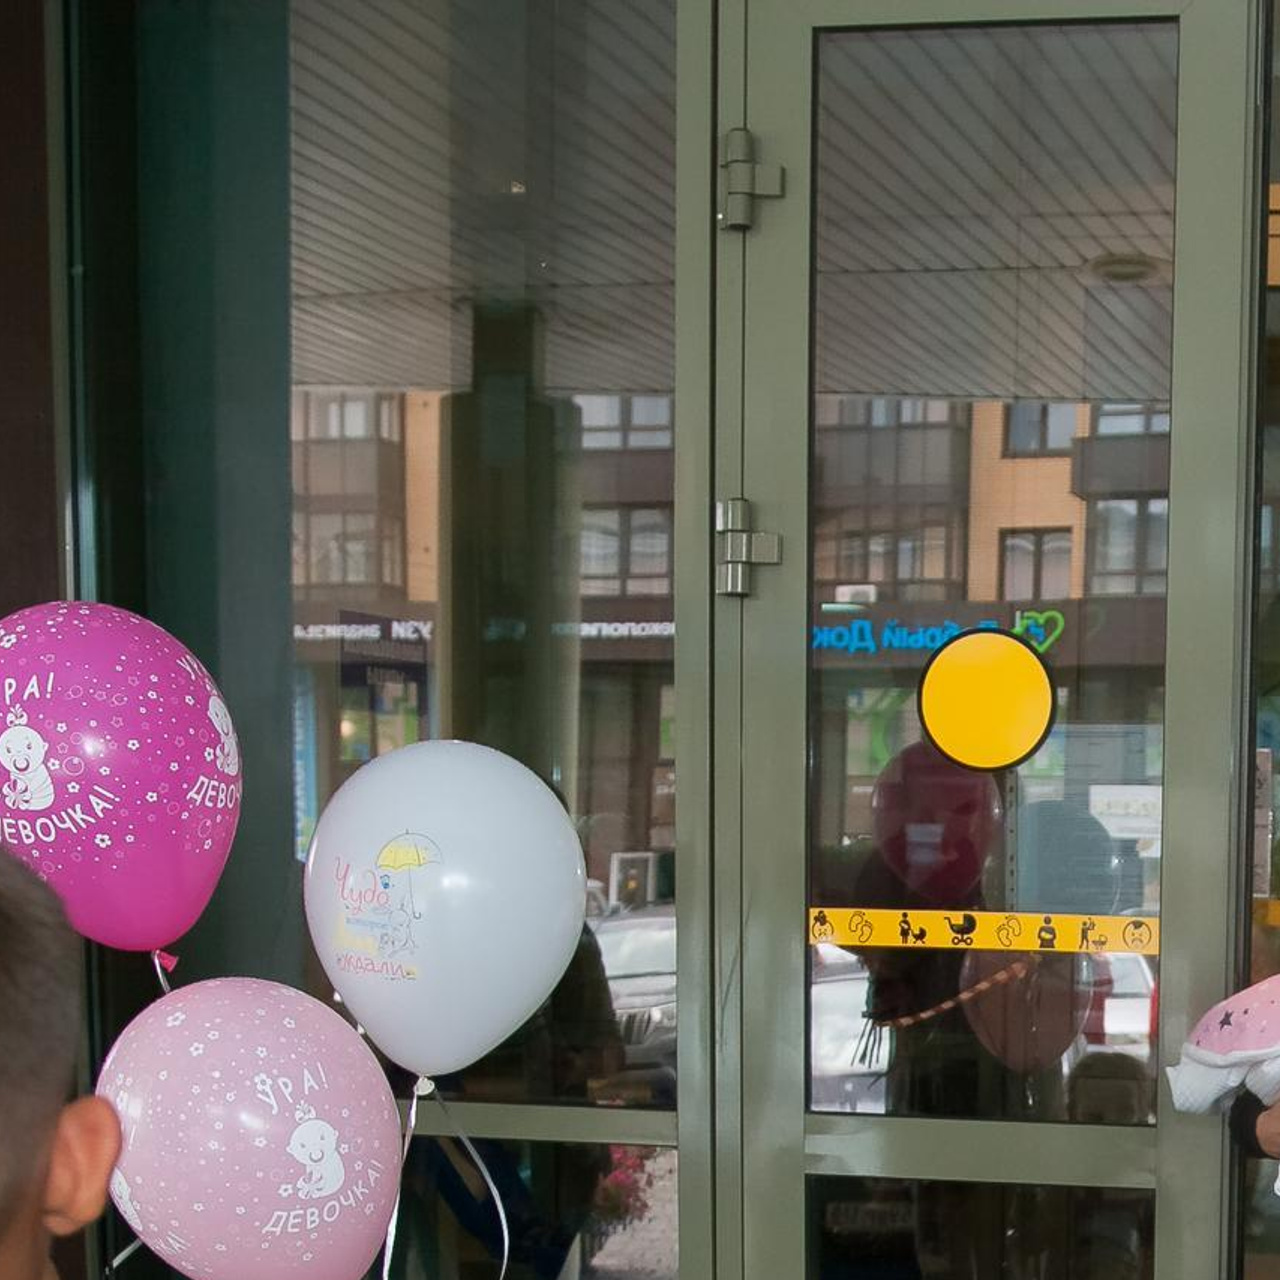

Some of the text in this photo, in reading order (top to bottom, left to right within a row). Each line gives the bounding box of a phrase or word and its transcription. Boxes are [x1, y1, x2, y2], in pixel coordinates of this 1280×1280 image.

[0, 785, 120, 844] ЕВОЧКА!
[256, 1062, 329, 1115] УРА!
[261, 1159, 385, 1236] ДЕВОЧКА!
